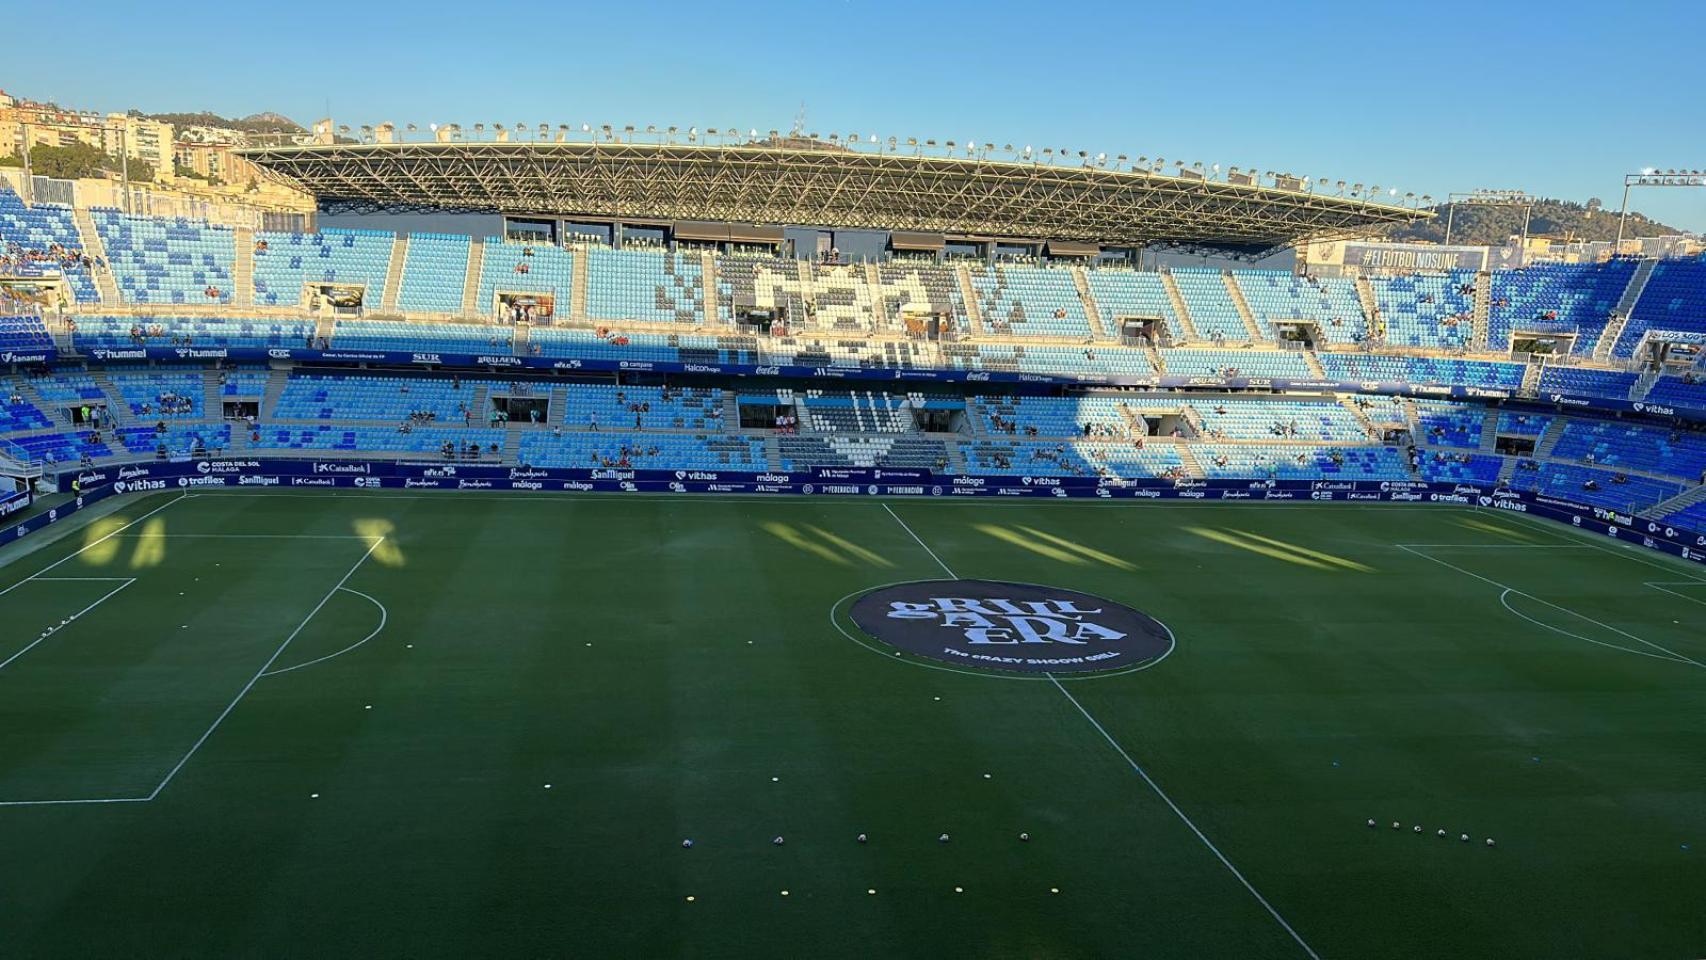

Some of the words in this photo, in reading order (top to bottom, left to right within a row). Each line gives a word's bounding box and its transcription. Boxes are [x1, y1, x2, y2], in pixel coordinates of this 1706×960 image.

[1363, 250, 1458, 269] #ELFUTBOLNOSUNE
[107, 349, 146, 358] hummel
[189, 349, 227, 357] hummel
[1419, 385, 1451, 394] hummel
[1646, 405, 1674, 414] vithas
[688, 472, 717, 480] vithas
[757, 473, 789, 483] málaga
[127, 478, 166, 492] vithas
[512, 481, 542, 490] málaga
[564, 481, 593, 490] málaga
[953, 477, 984, 486] málaga
[1179, 490, 1204, 498] málaga
[1494, 499, 1526, 511] vithas
[944, 648, 969, 657] The
